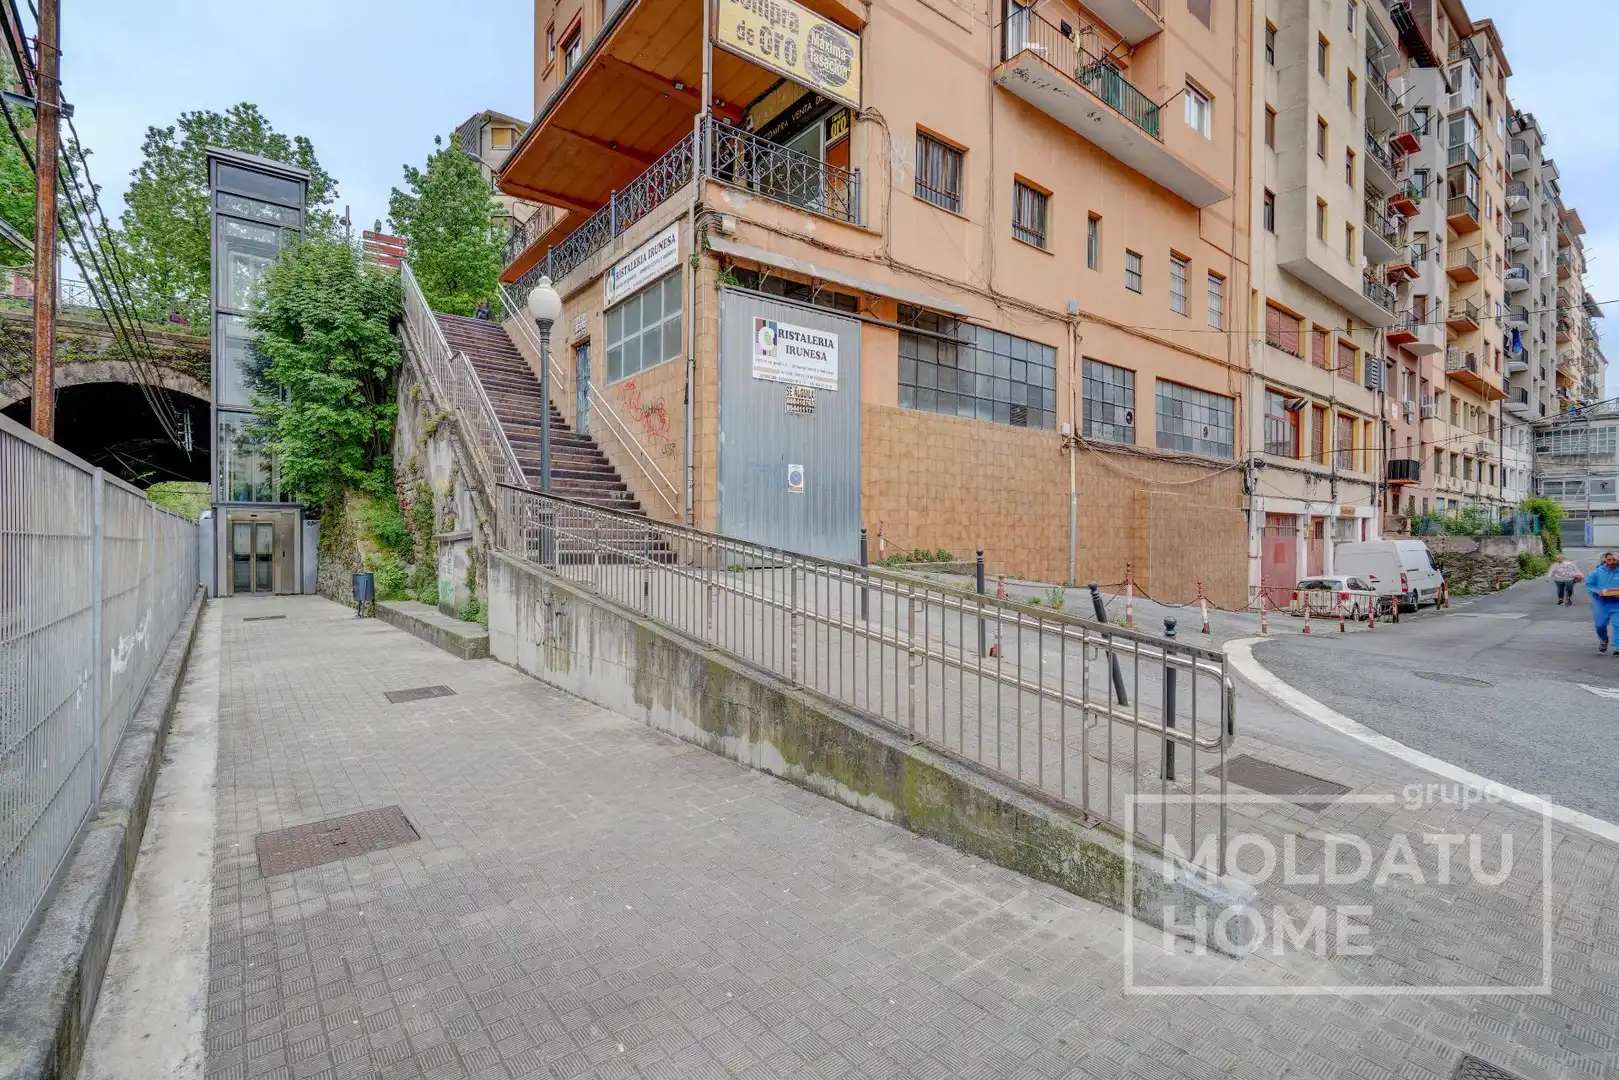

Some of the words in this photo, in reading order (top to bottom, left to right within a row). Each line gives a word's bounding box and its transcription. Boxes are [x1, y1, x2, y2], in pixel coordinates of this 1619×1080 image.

[736, 20, 755, 46] de
[648, 233, 676, 260] IRUNESA
[786, 345, 827, 361] IRUNESA
